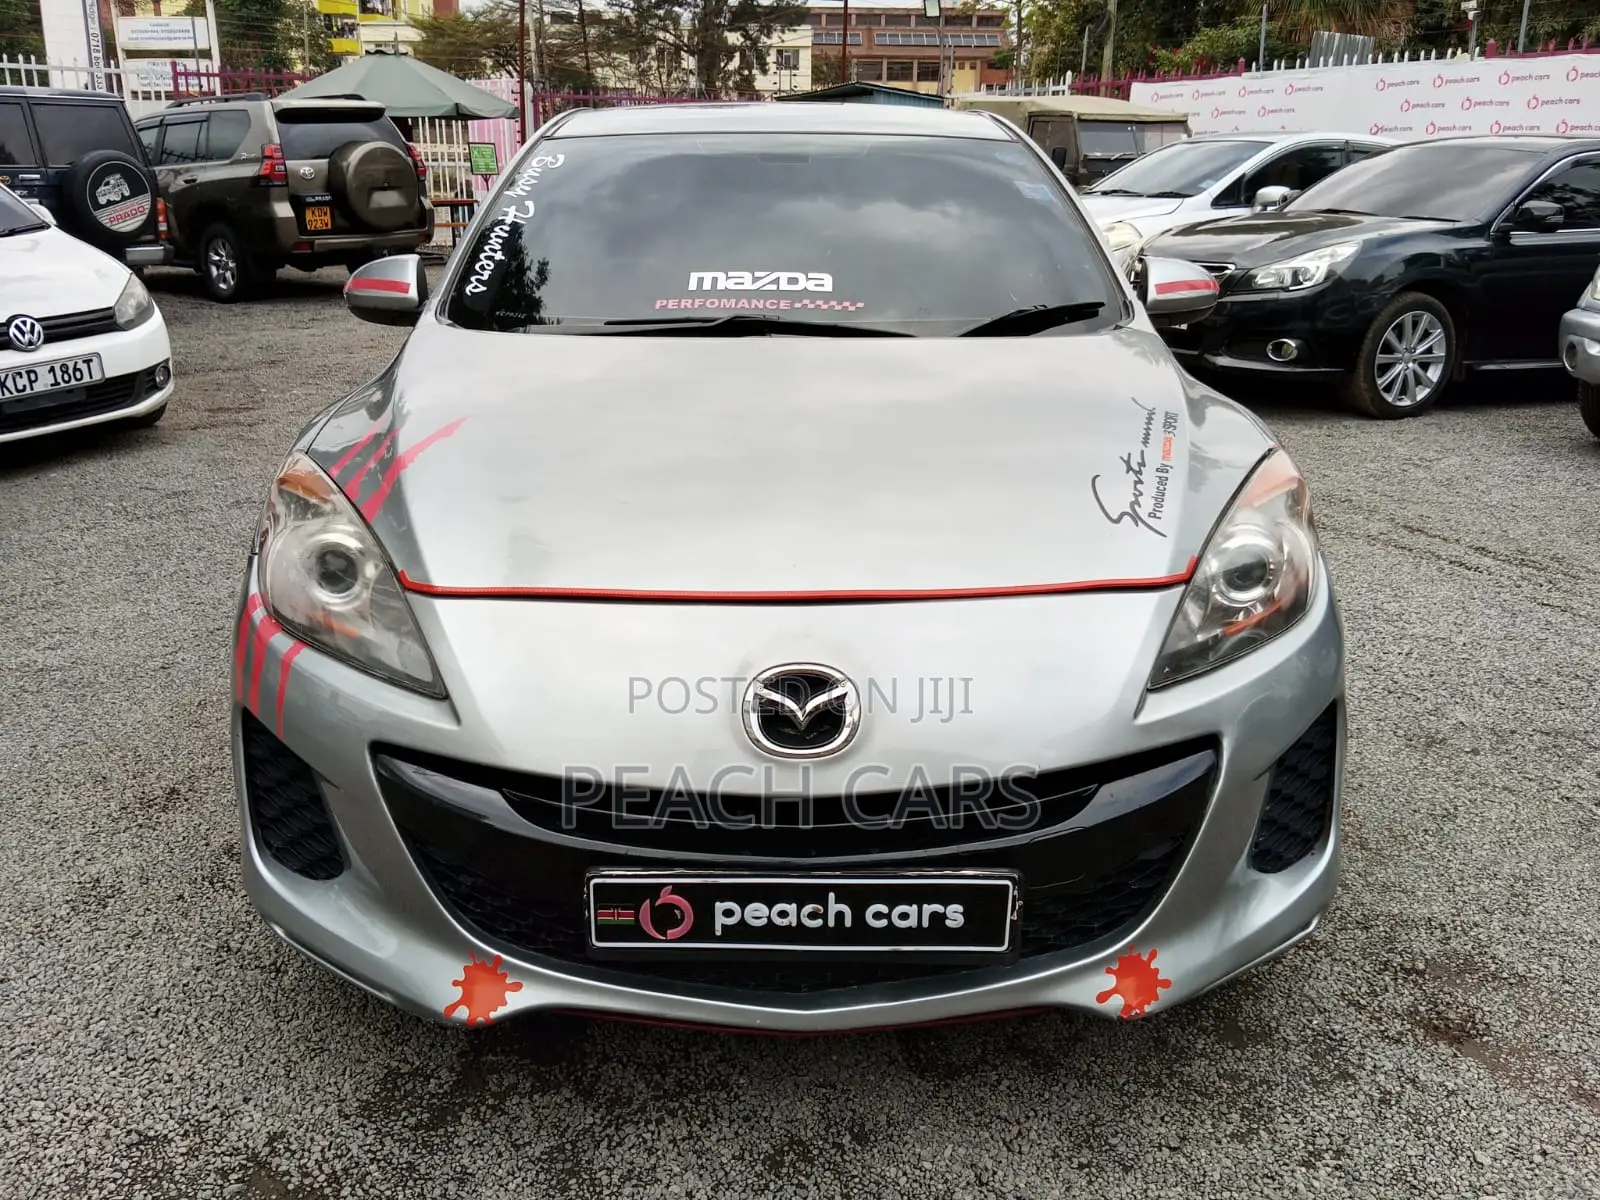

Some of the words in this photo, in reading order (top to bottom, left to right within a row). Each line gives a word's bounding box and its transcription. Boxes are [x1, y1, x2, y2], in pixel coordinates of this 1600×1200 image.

[1444, 76, 1465, 85] peach
[1511, 73, 1533, 83] peach
[1534, 73, 1550, 81] cars
[1387, 80, 1405, 89] peach
[1412, 102, 1430, 110] peach
[1473, 99, 1493, 108] peach
[1540, 96, 1563, 107] peach
[1564, 97, 1580, 105] cars
[1437, 124, 1456, 133] peach
[1502, 123, 1524, 133] peach
[1569, 122, 1593, 132] peach
[108, 205, 146, 225] PRADO
[311, 207, 328, 218] KDW
[307, 218, 329, 230] 923W
[465, 200, 535, 297] Hunters
[655, 298, 792, 310] PERFOMANCE
[0, 369, 39, 397] KCP
[48, 358, 94, 387] 186T
[1155, 462, 1174, 474] By
[1147, 471, 1169, 520] Produced
[714, 892, 852, 936] peach
[864, 902, 965, 929] cars
